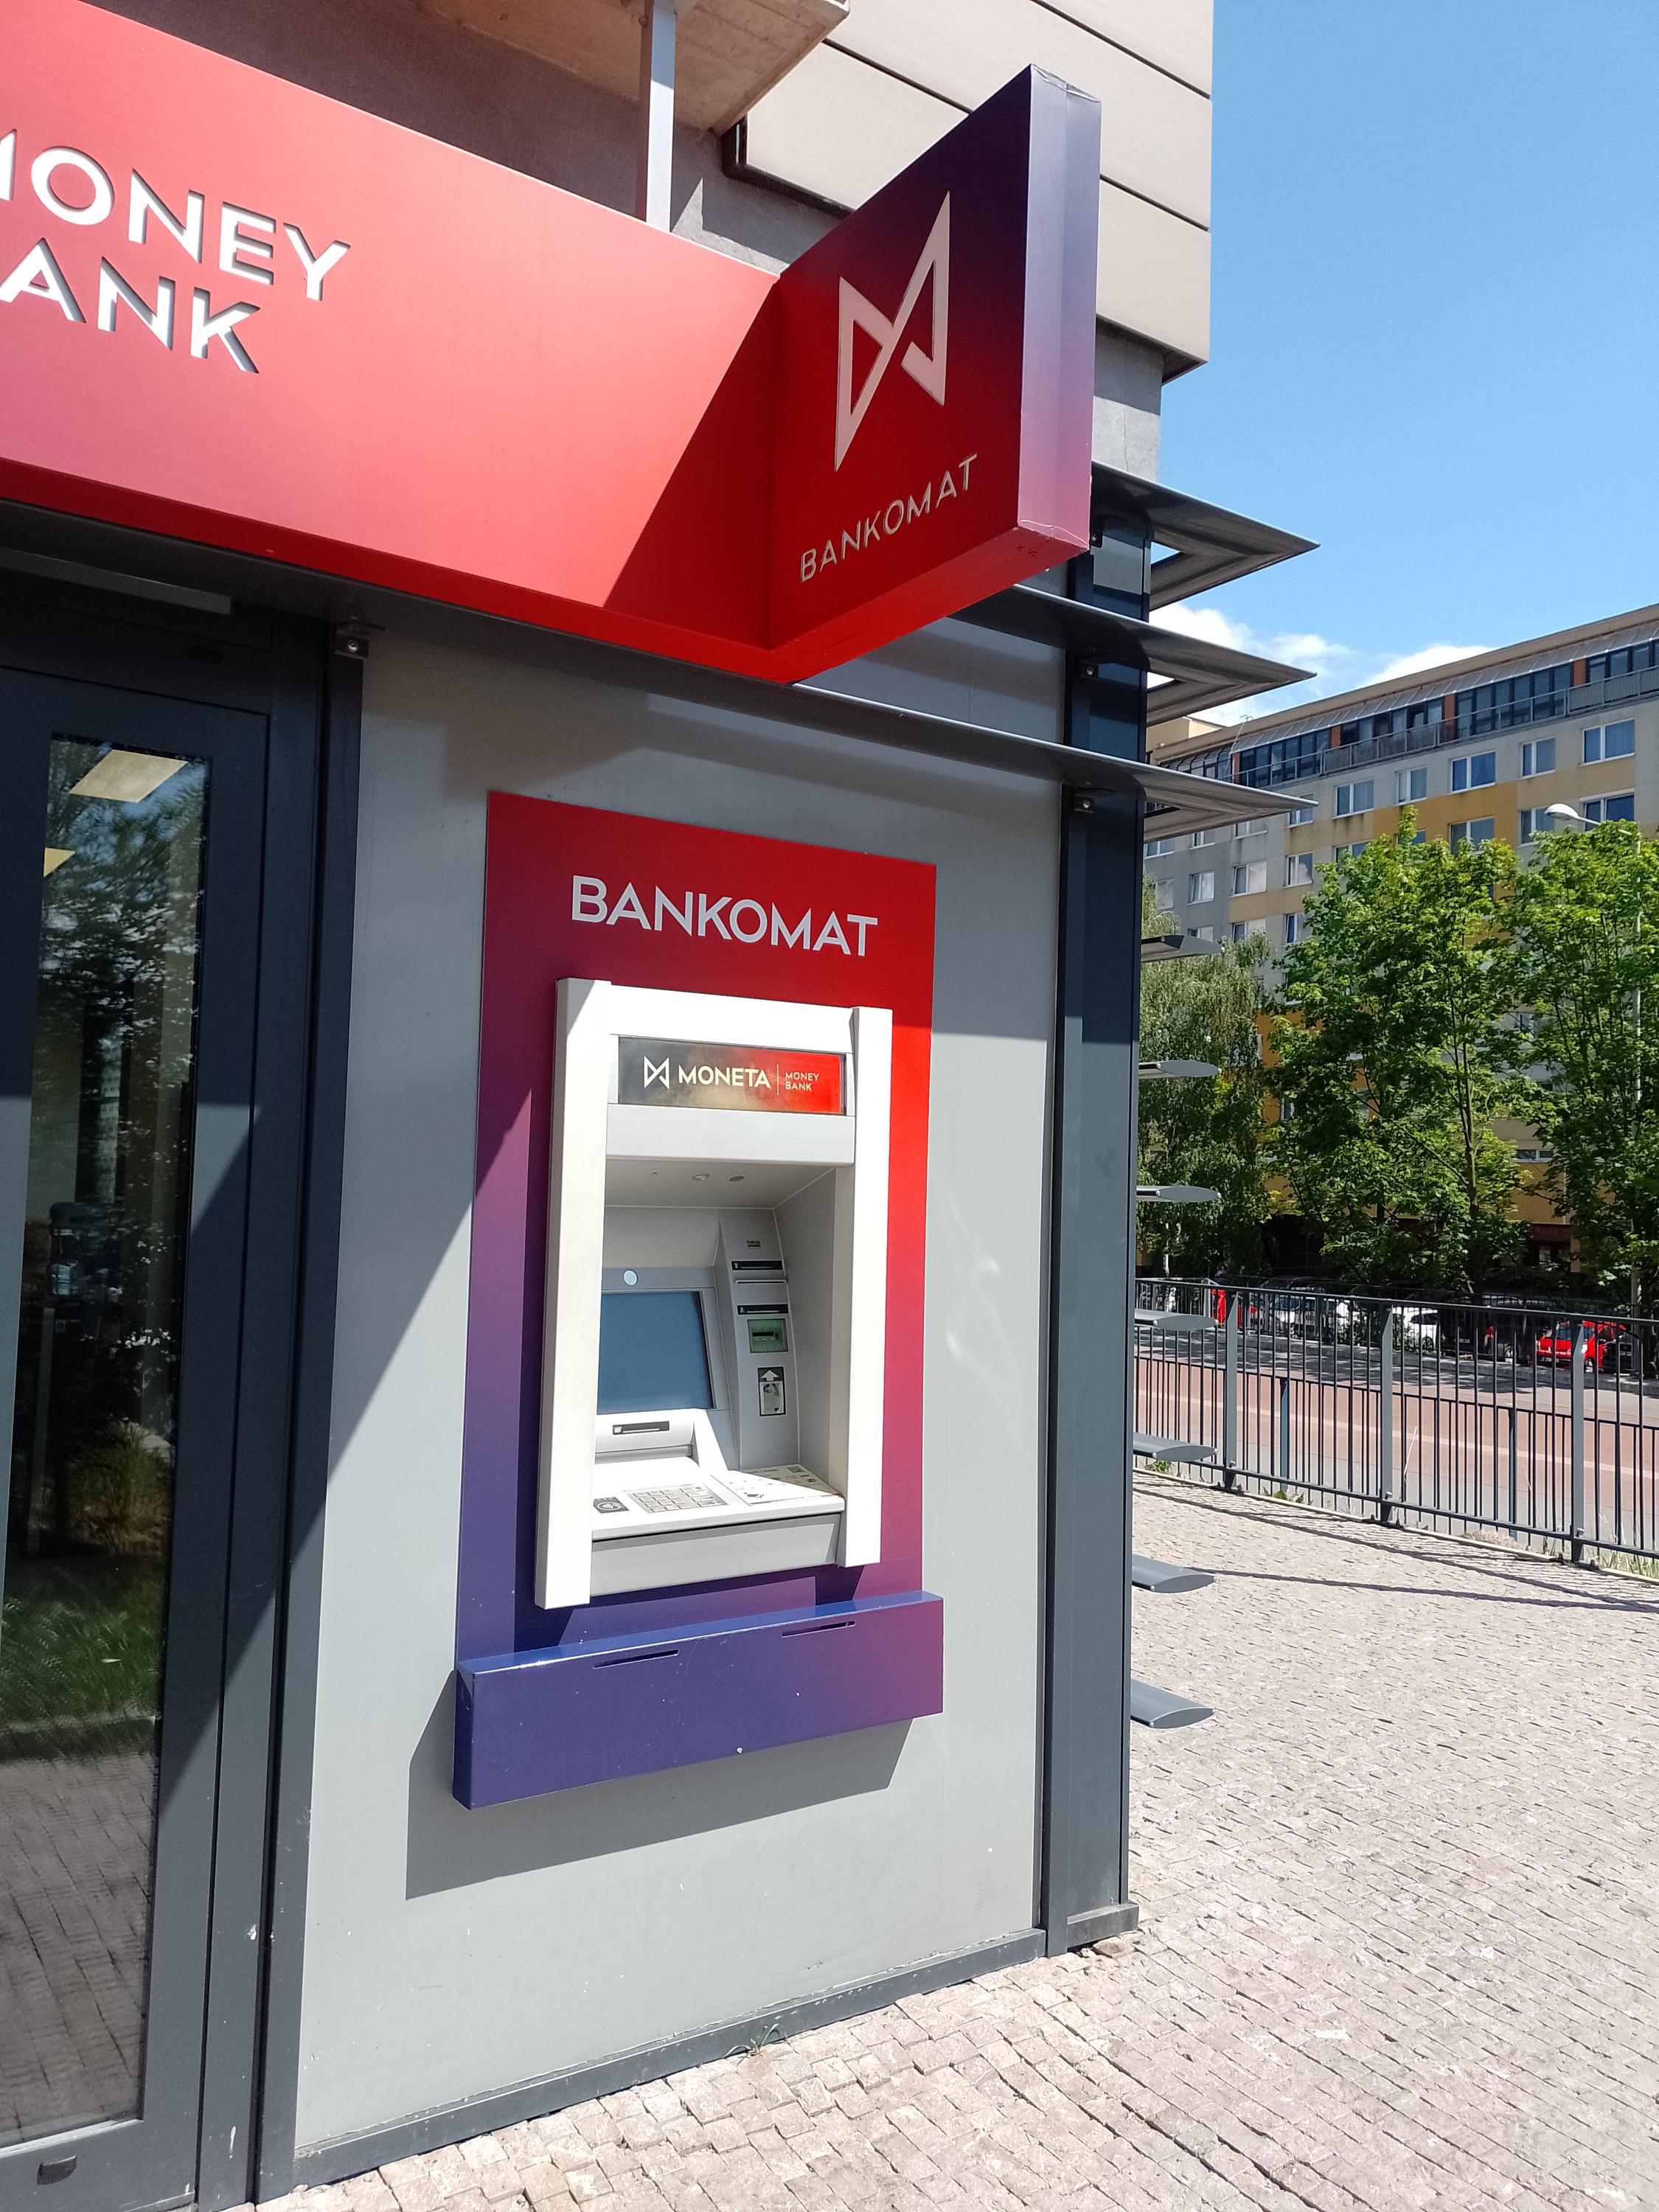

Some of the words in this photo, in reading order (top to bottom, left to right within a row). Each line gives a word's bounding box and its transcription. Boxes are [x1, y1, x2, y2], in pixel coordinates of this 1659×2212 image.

[0, 129, 351, 301] ONEY
[800, 453, 977, 582] BANKOMAT
[571, 874, 878, 956] BANKOMAT
[678, 1065, 771, 1088] MONETA
[785, 1071, 820, 1082] MONEY
[785, 1082, 813, 1091] BANK
